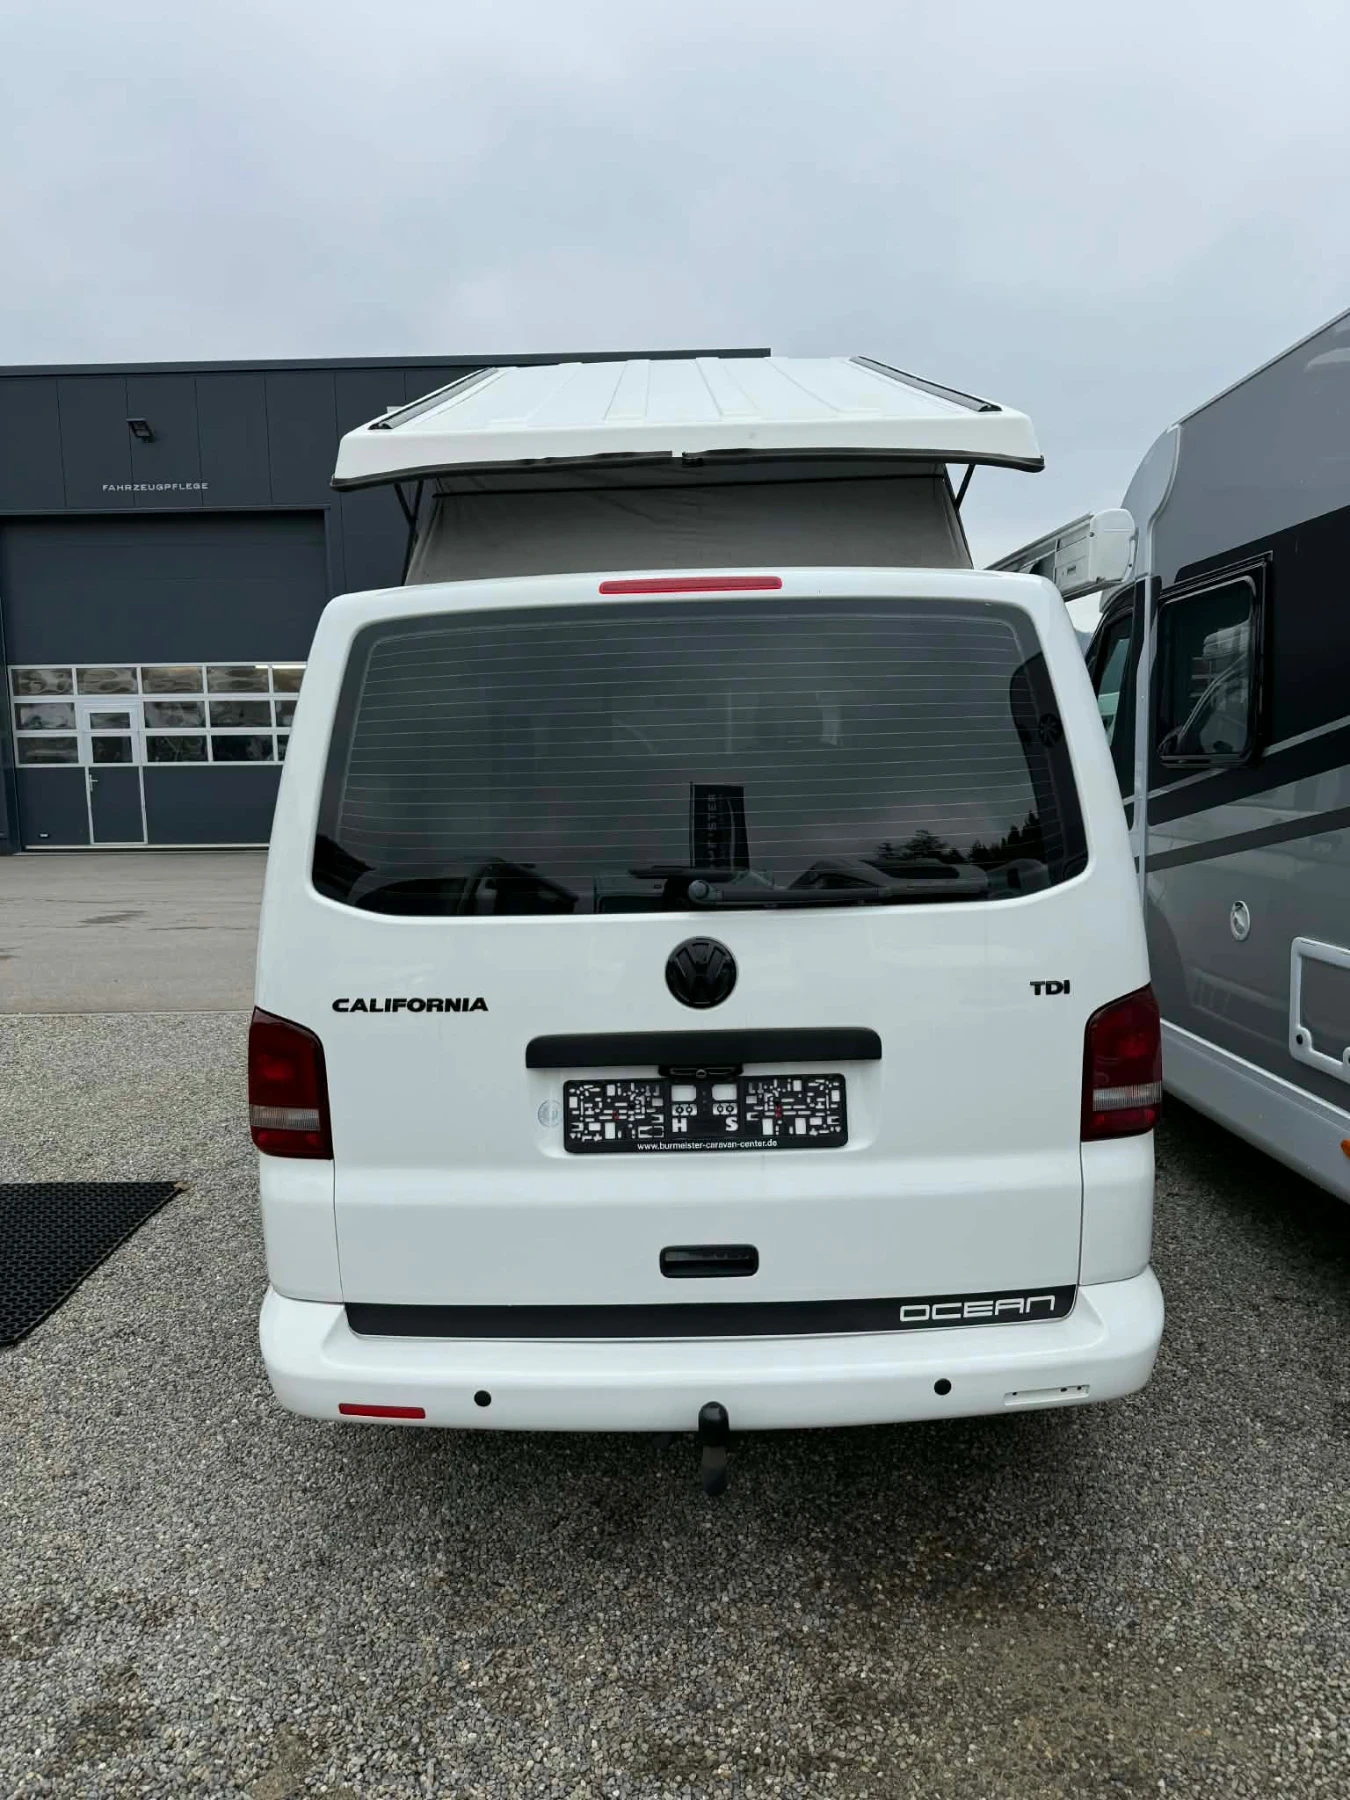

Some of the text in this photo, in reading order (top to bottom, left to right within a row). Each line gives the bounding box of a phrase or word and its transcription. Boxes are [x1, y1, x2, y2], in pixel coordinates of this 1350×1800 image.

[102, 482, 209, 492] FAHRZEUGPFLEGE
[1029, 979, 1071, 996] TDI
[332, 997, 489, 1013] CALIFORNIA
[637, 1139, 778, 1151] www.burmeister-caravan-center.de
[899, 1295, 1056, 1322] OCEAN
